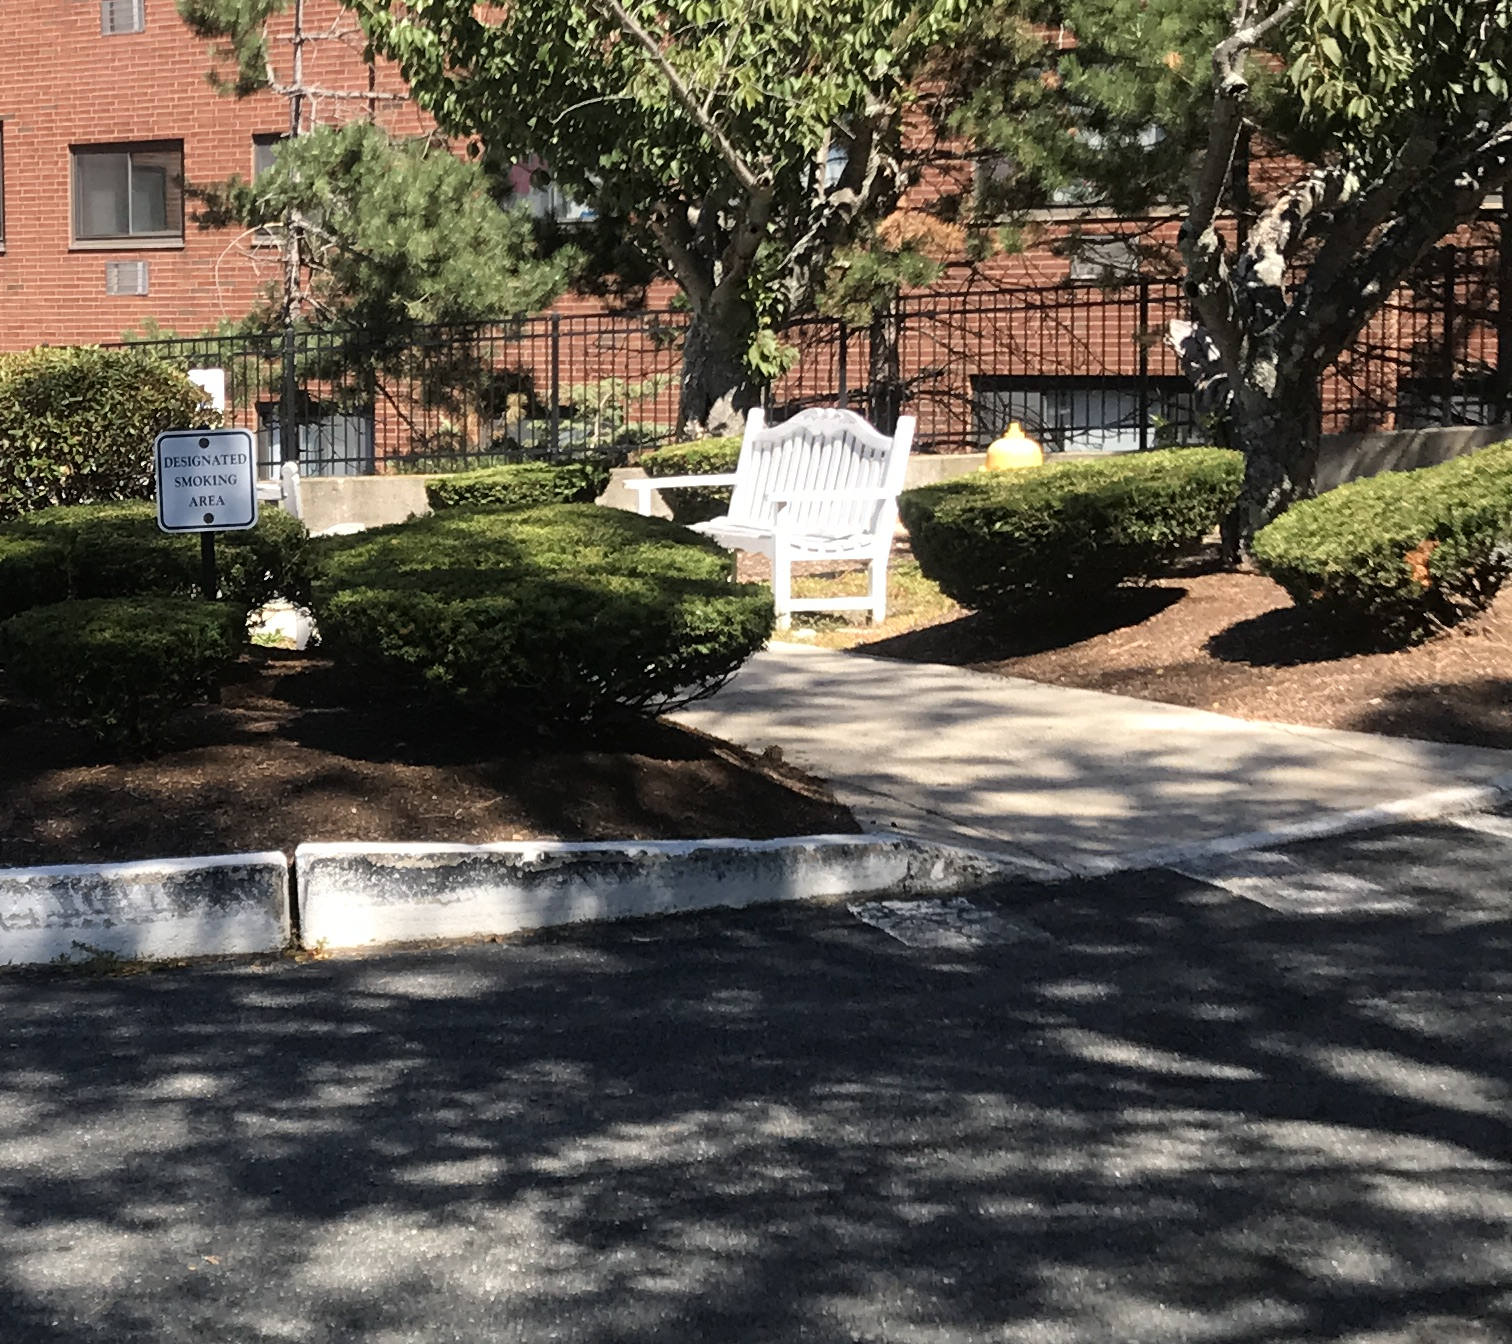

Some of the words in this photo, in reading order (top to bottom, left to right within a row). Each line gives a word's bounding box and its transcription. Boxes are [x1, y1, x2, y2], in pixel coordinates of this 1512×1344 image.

[164, 453, 247, 468] DESIGNATED
[174, 474, 238, 488] SMOKING
[188, 495, 226, 508] AREA
